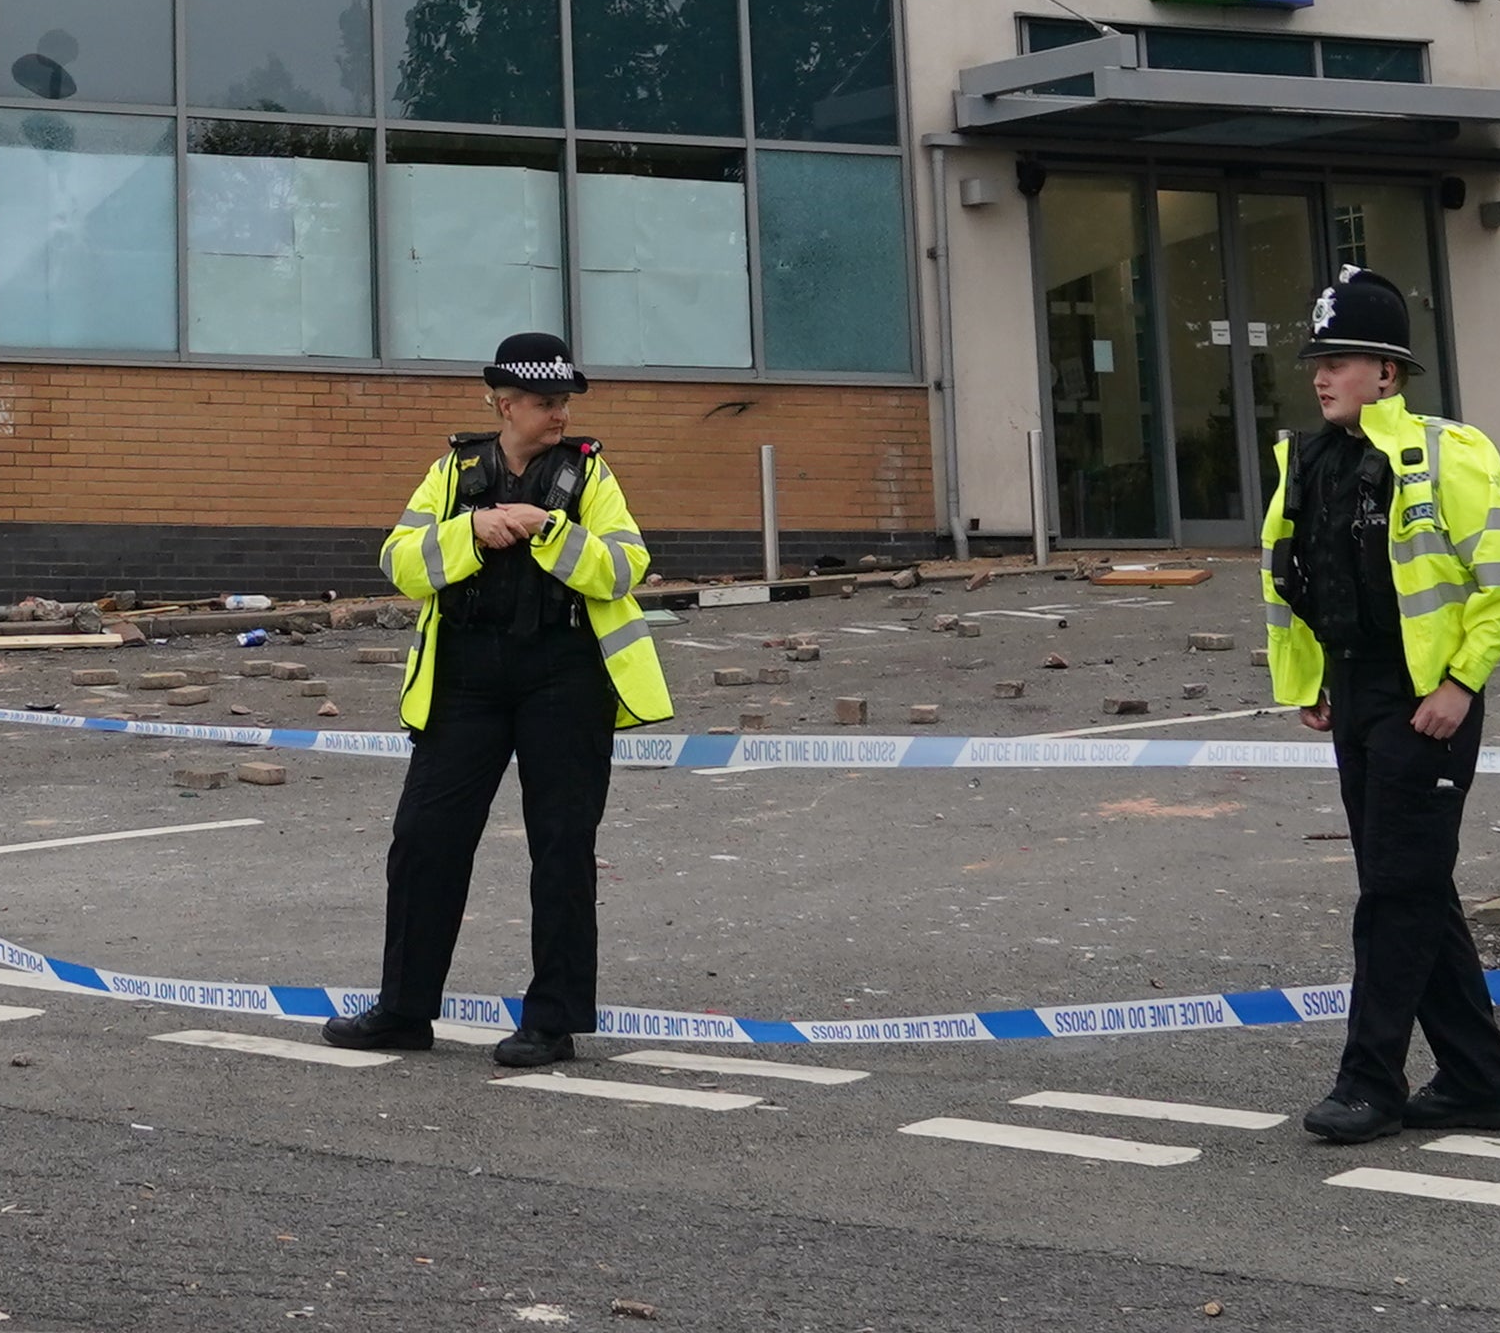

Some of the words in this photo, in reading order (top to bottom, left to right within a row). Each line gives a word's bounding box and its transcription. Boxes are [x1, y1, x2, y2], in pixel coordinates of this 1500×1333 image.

[8, 950, 44, 973] POLICE
[113, 976, 150, 996] CROSS
[154, 981, 177, 999] NOT
[180, 985, 196, 1003] DO
[200, 986, 225, 1007] LINE
[227, 989, 267, 1010] POLICE
[1302, 989, 1345, 1016] CROSS
[459, 999, 500, 1023] POLICE
[616, 1011, 641, 1027] NOT
[1056, 1009, 1097, 1033] CROSS
[1100, 1007, 1125, 1031] NOT
[1128, 1006, 1146, 1028] DO
[1150, 1004, 1177, 1027] LINE
[1179, 999, 1224, 1024] POLICE
[644, 1014, 660, 1030] DO
[664, 1015, 690, 1032] LINE
[692, 1019, 734, 1038] POLICE
[855, 1024, 878, 1039] NOT
[883, 1023, 899, 1039] DO
[902, 1022, 931, 1038] LINE
[932, 1018, 976, 1038] POLICE
[811, 1025, 853, 1040] CROSS
